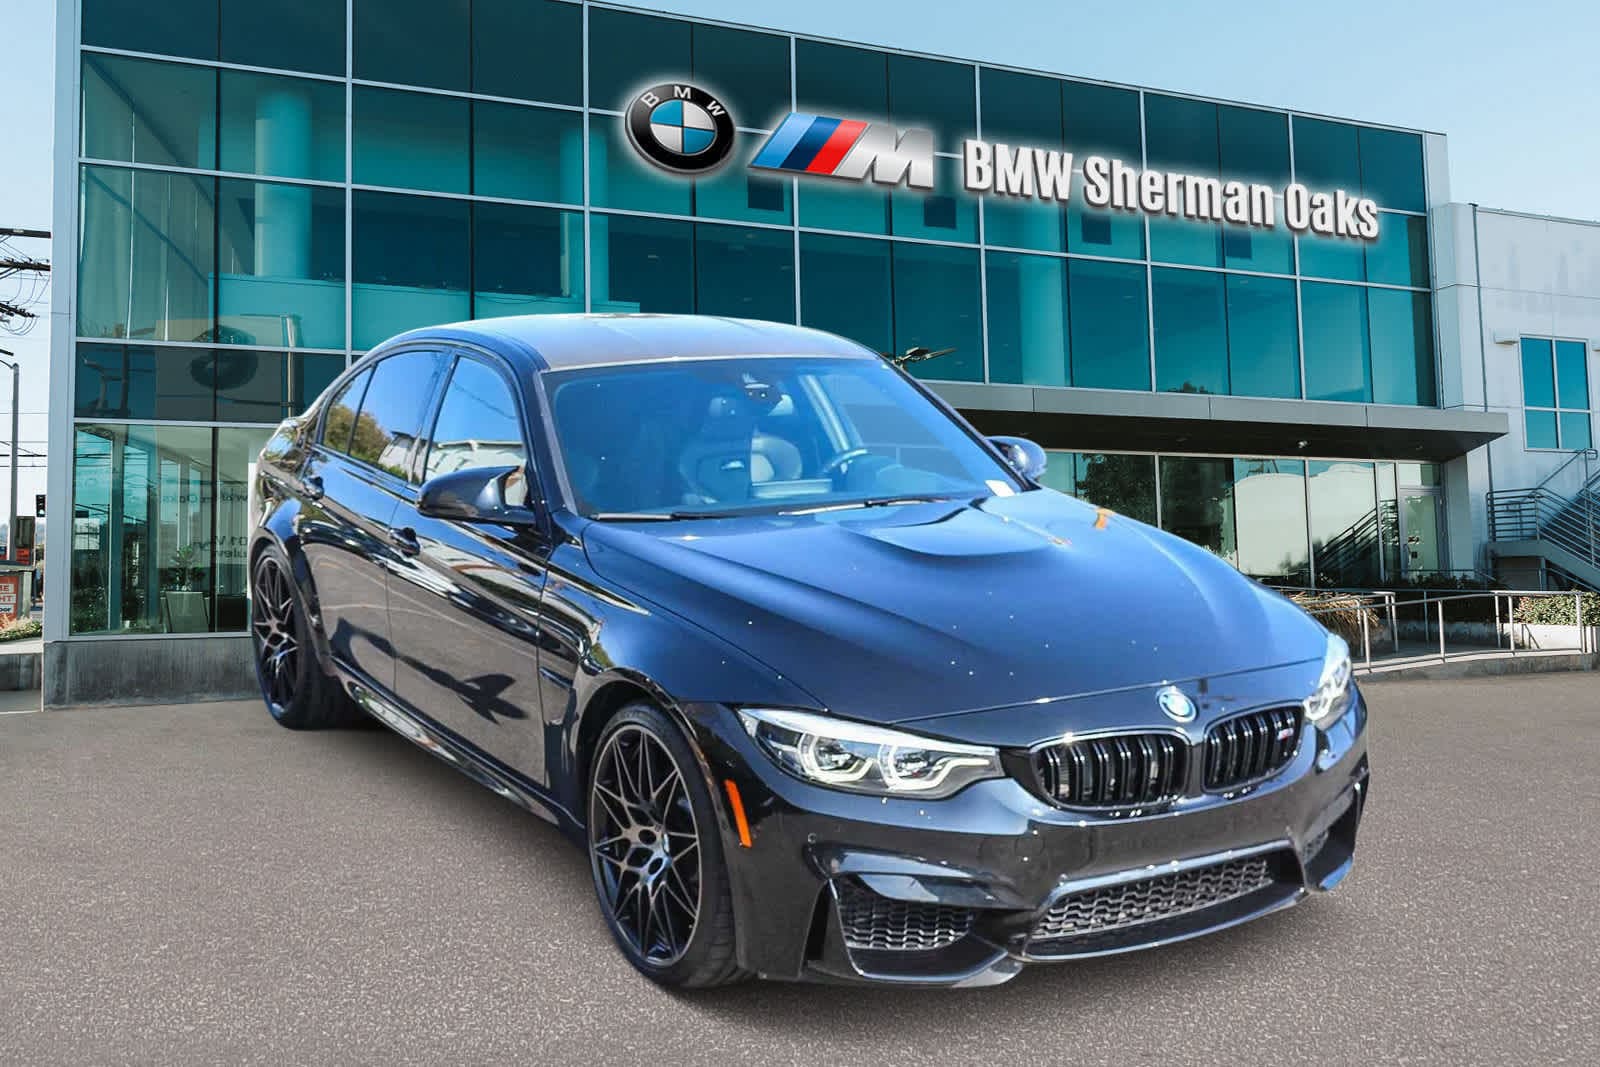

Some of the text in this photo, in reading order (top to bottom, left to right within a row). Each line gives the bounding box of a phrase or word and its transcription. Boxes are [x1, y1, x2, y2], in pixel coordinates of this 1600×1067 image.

[640, 86, 725, 117] BMW
[963, 138, 1379, 240] BMW Sherman Oaks
